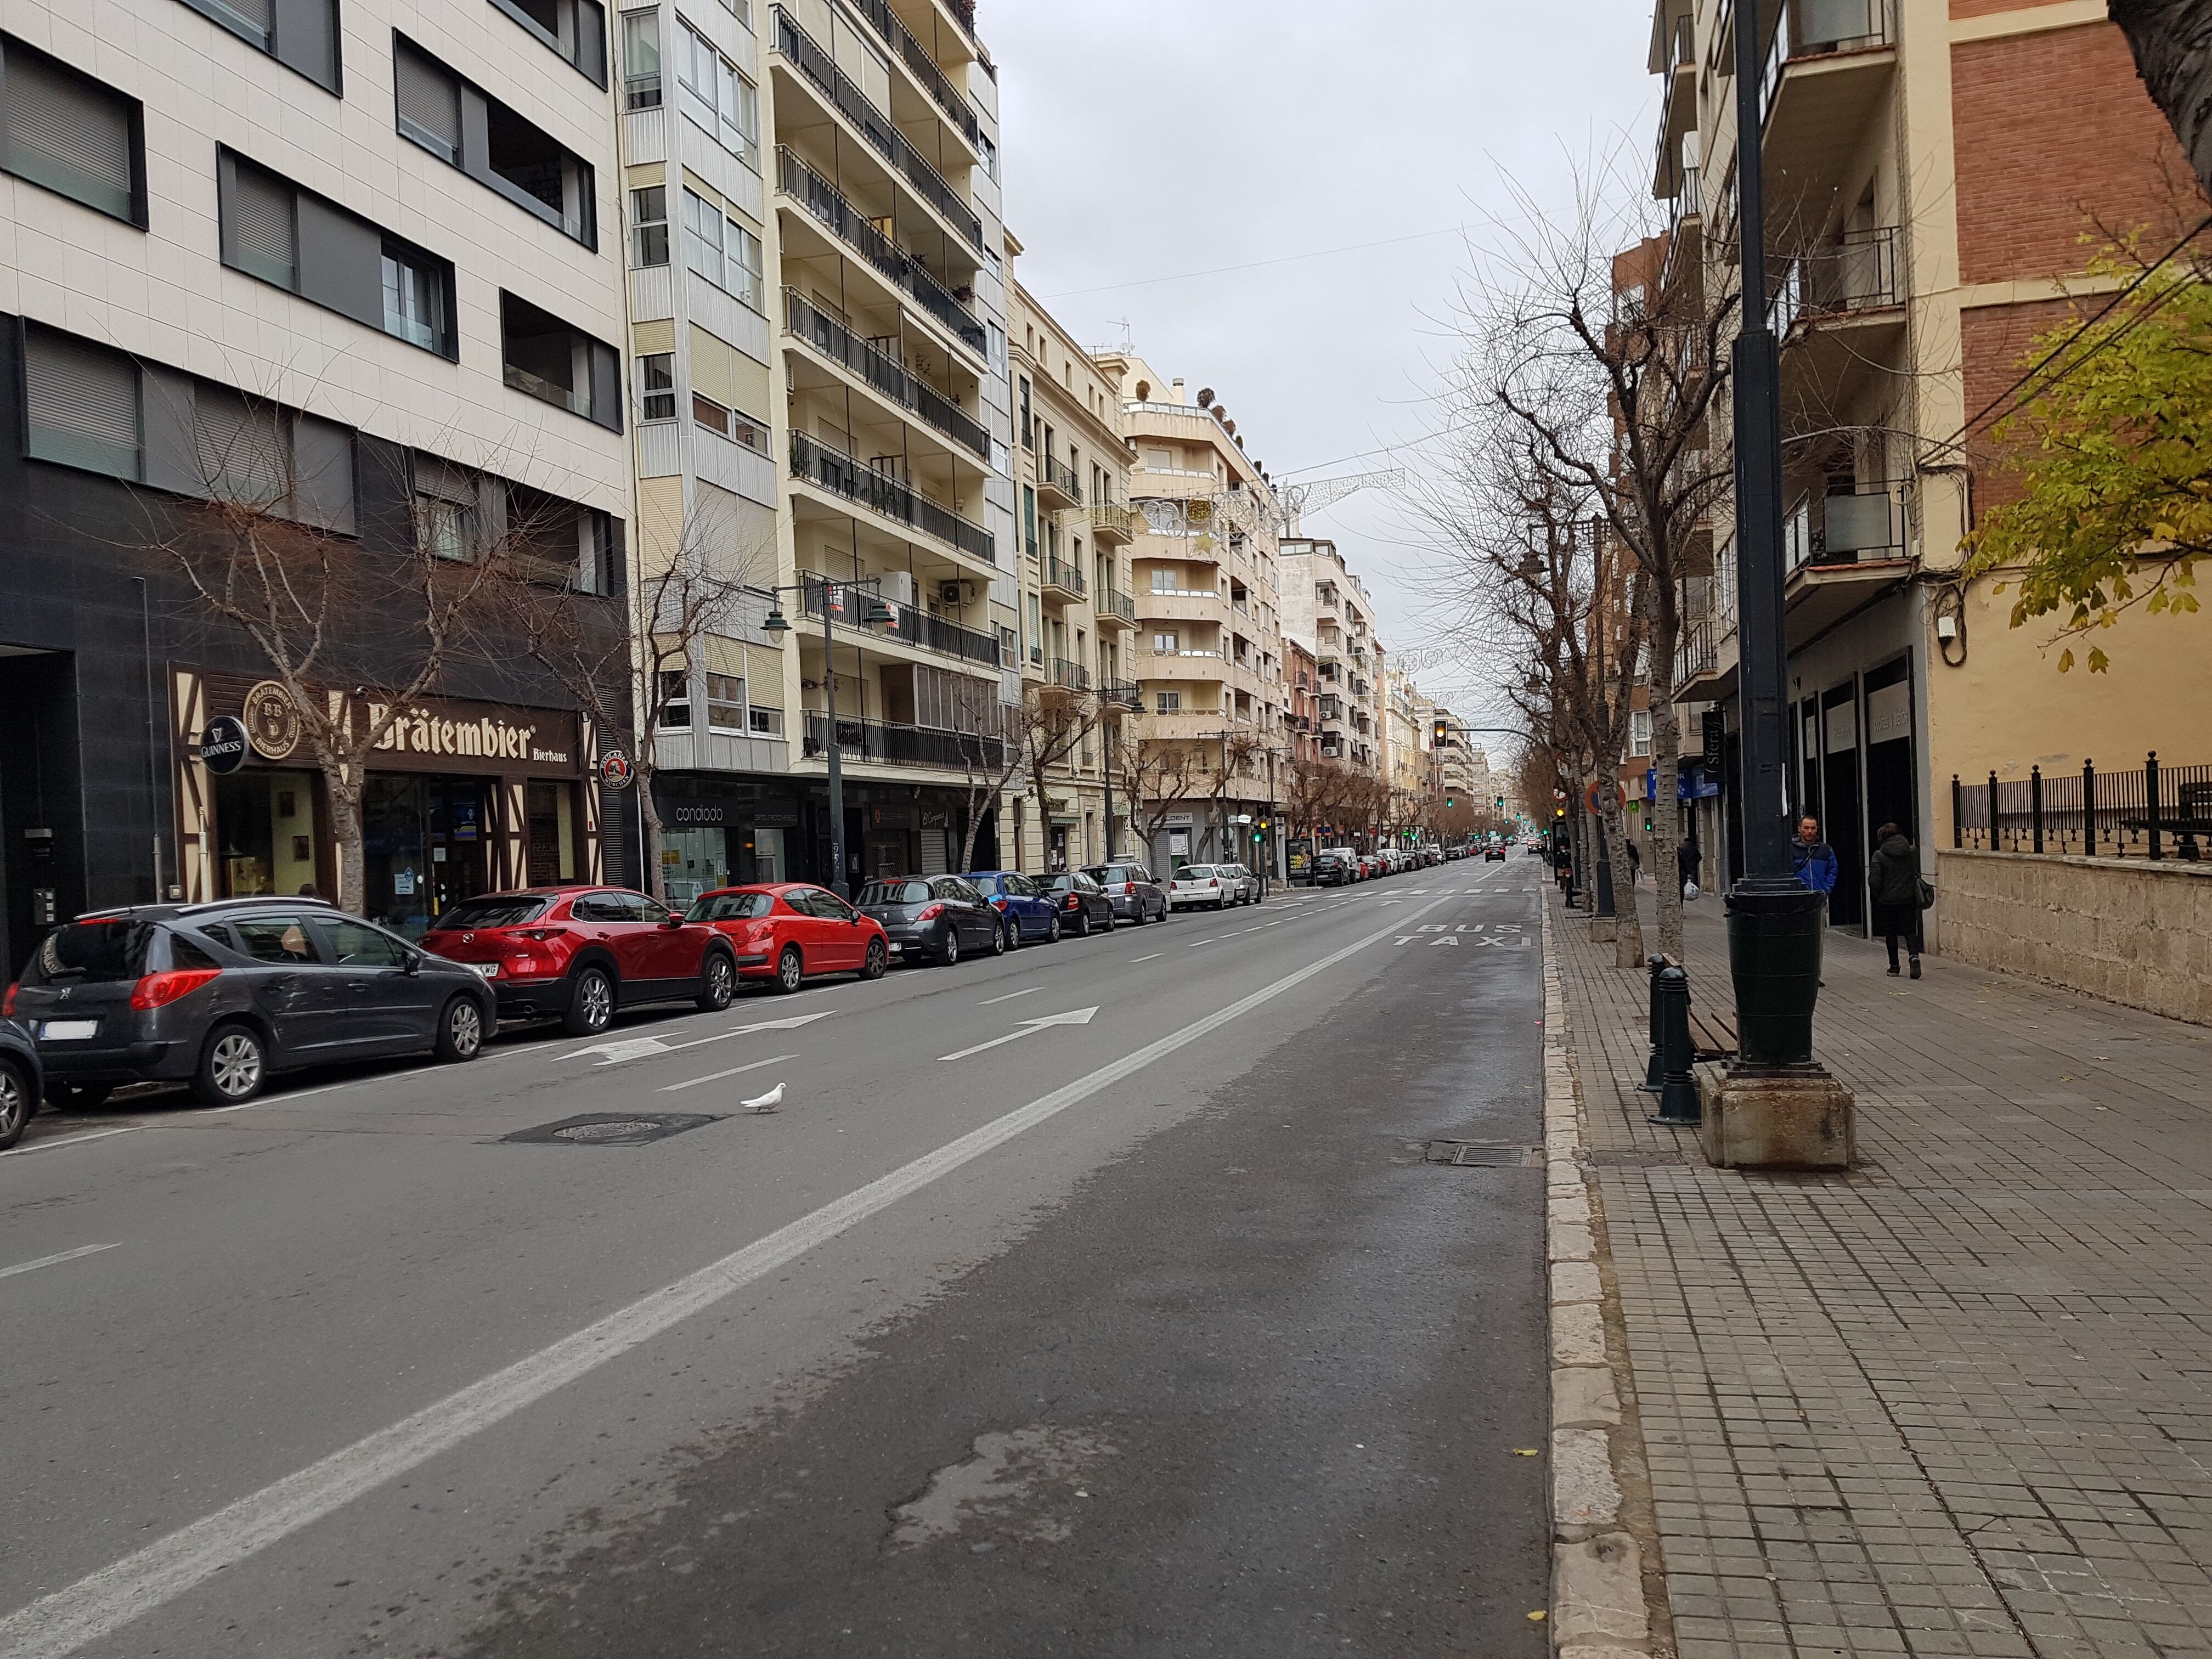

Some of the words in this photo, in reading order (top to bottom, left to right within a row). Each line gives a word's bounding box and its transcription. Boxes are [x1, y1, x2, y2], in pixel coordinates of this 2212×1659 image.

[201, 741, 241, 758] GUINNESS
[255, 737, 290, 754] BIERHAUS
[533, 747, 567, 763] Bierhaus
[676, 804, 723, 821] condiodo
[1415, 924, 1522, 933] BUS
[1393, 935, 1531, 947] TAXI
